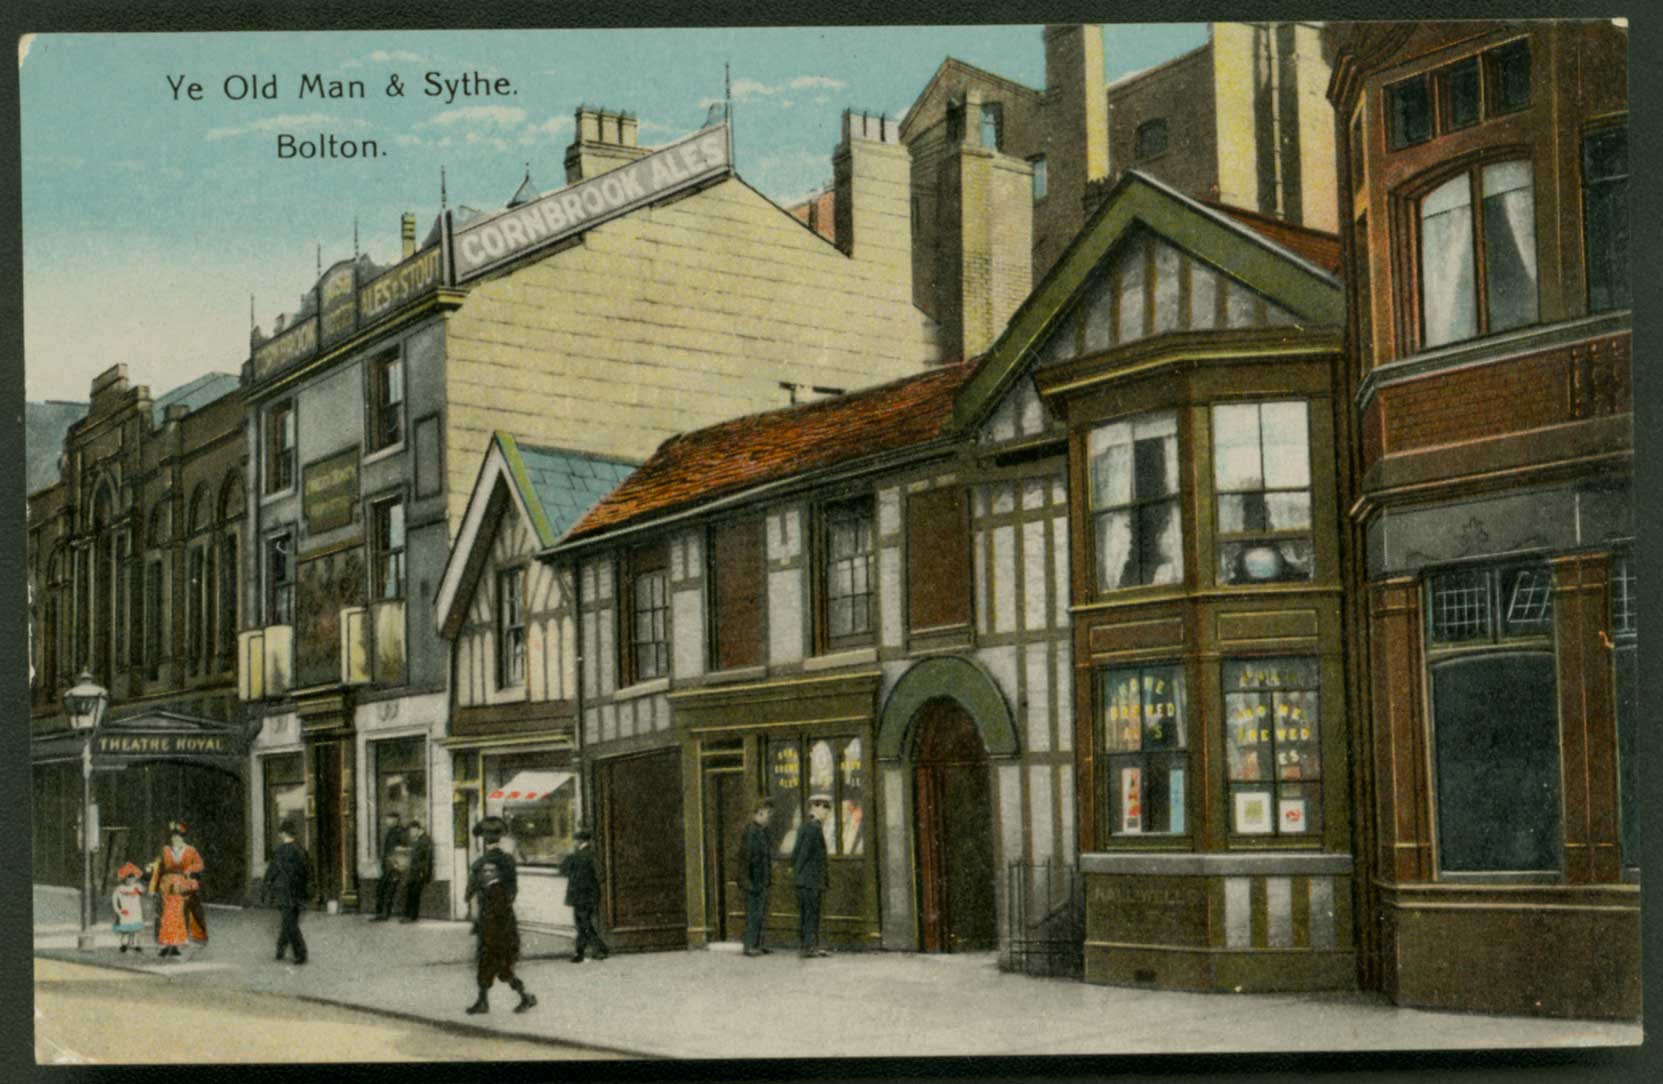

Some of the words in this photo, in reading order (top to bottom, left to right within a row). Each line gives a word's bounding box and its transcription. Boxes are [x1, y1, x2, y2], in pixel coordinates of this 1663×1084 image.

[461, 166, 647, 265] CORNBROOK
[653, 135, 726, 191] ALES
[100, 737, 170, 751] THEATRE
[176, 737, 225, 751] ROYAL
